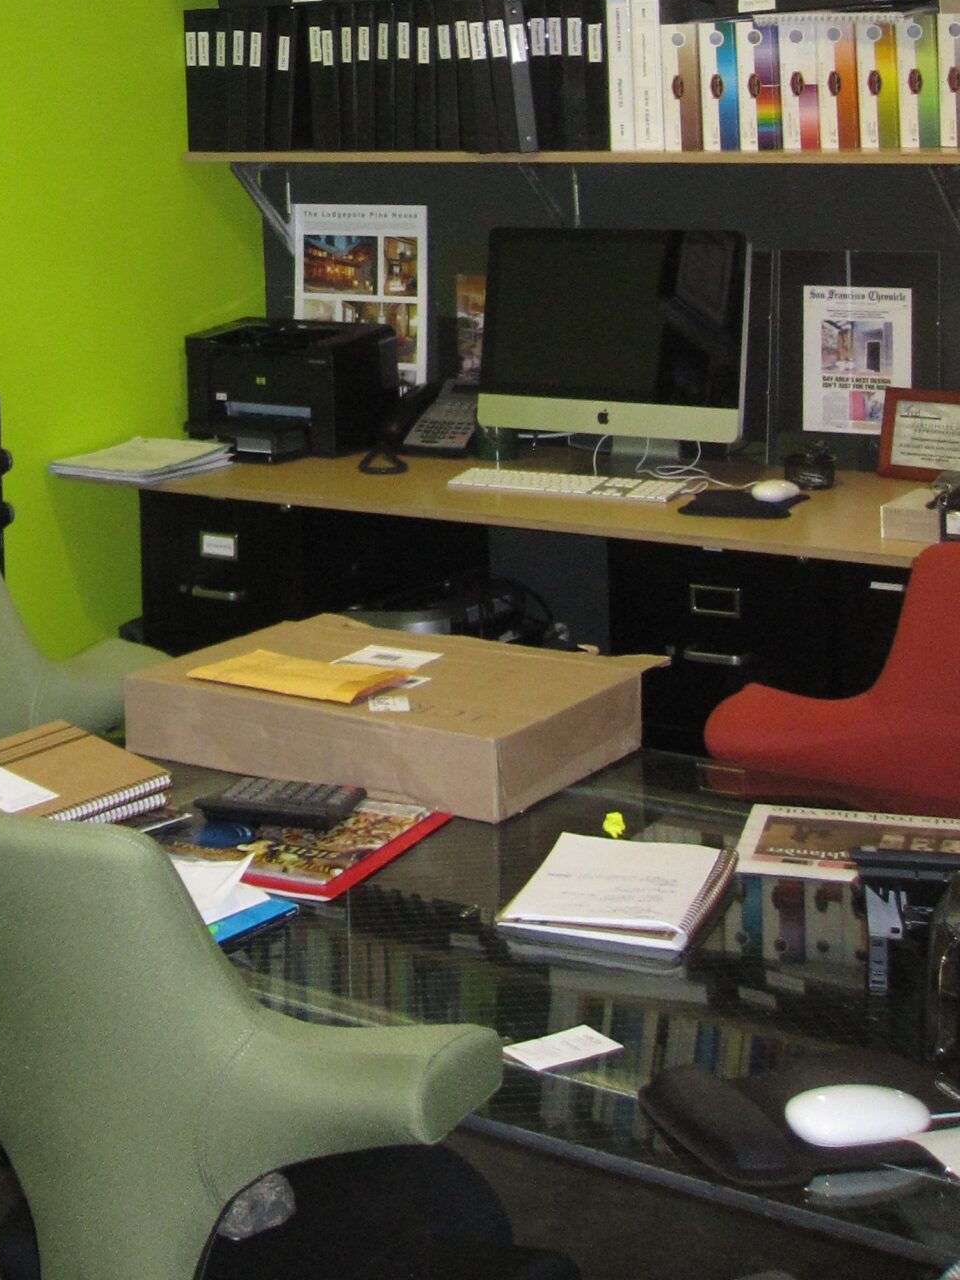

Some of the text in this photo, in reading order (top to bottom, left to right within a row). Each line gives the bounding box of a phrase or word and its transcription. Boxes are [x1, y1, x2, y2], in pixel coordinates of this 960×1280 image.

[321, 210, 365, 218] Lodgepole
[809, 289, 906, 302] San Francisco Chronicle
[771, 807, 817, 816] vote
[825, 811, 858, 820] the
[867, 814, 913, 824] rock
